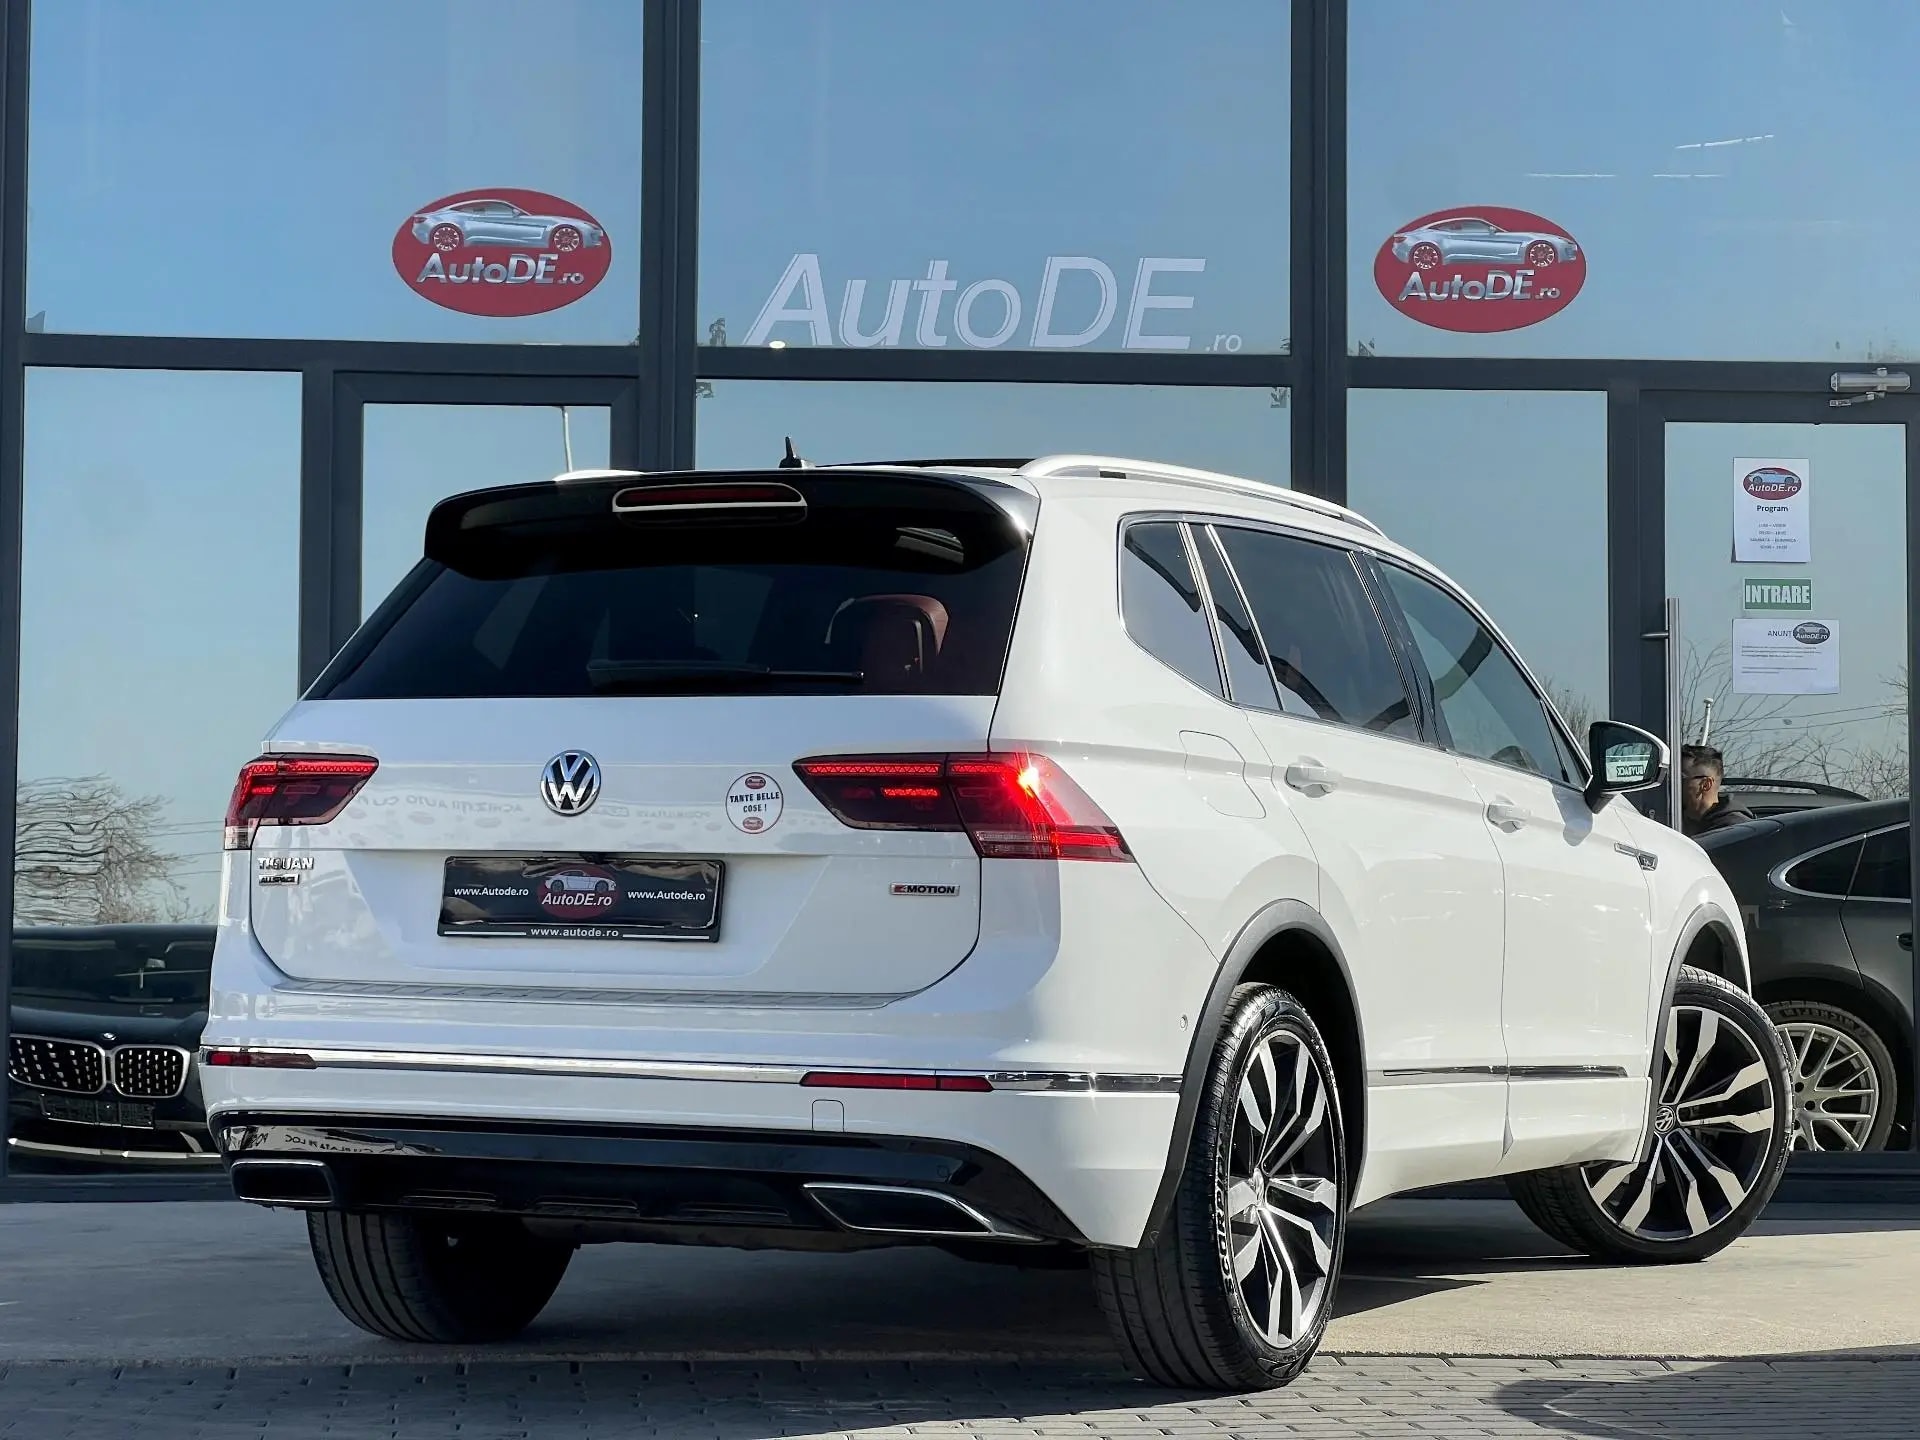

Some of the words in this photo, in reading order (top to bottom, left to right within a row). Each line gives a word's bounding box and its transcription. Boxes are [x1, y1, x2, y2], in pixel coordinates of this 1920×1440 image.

[1748, 483, 1798, 492] AutoDE.ro
[1756, 505, 1789, 513] Program
[1745, 585, 1810, 603] INTRARE
[730, 794, 753, 803] TANTE
[757, 792, 780, 801] BELLE
[743, 805, 762, 813] COSE
[258, 857, 315, 870] TIGUAN
[454, 886, 529, 897] www.Autode.ro
[627, 889, 706, 901] www.Autode.ro
[541, 892, 613, 907] AutoDE.ro
[530, 927, 619, 938] www.autode.ro
